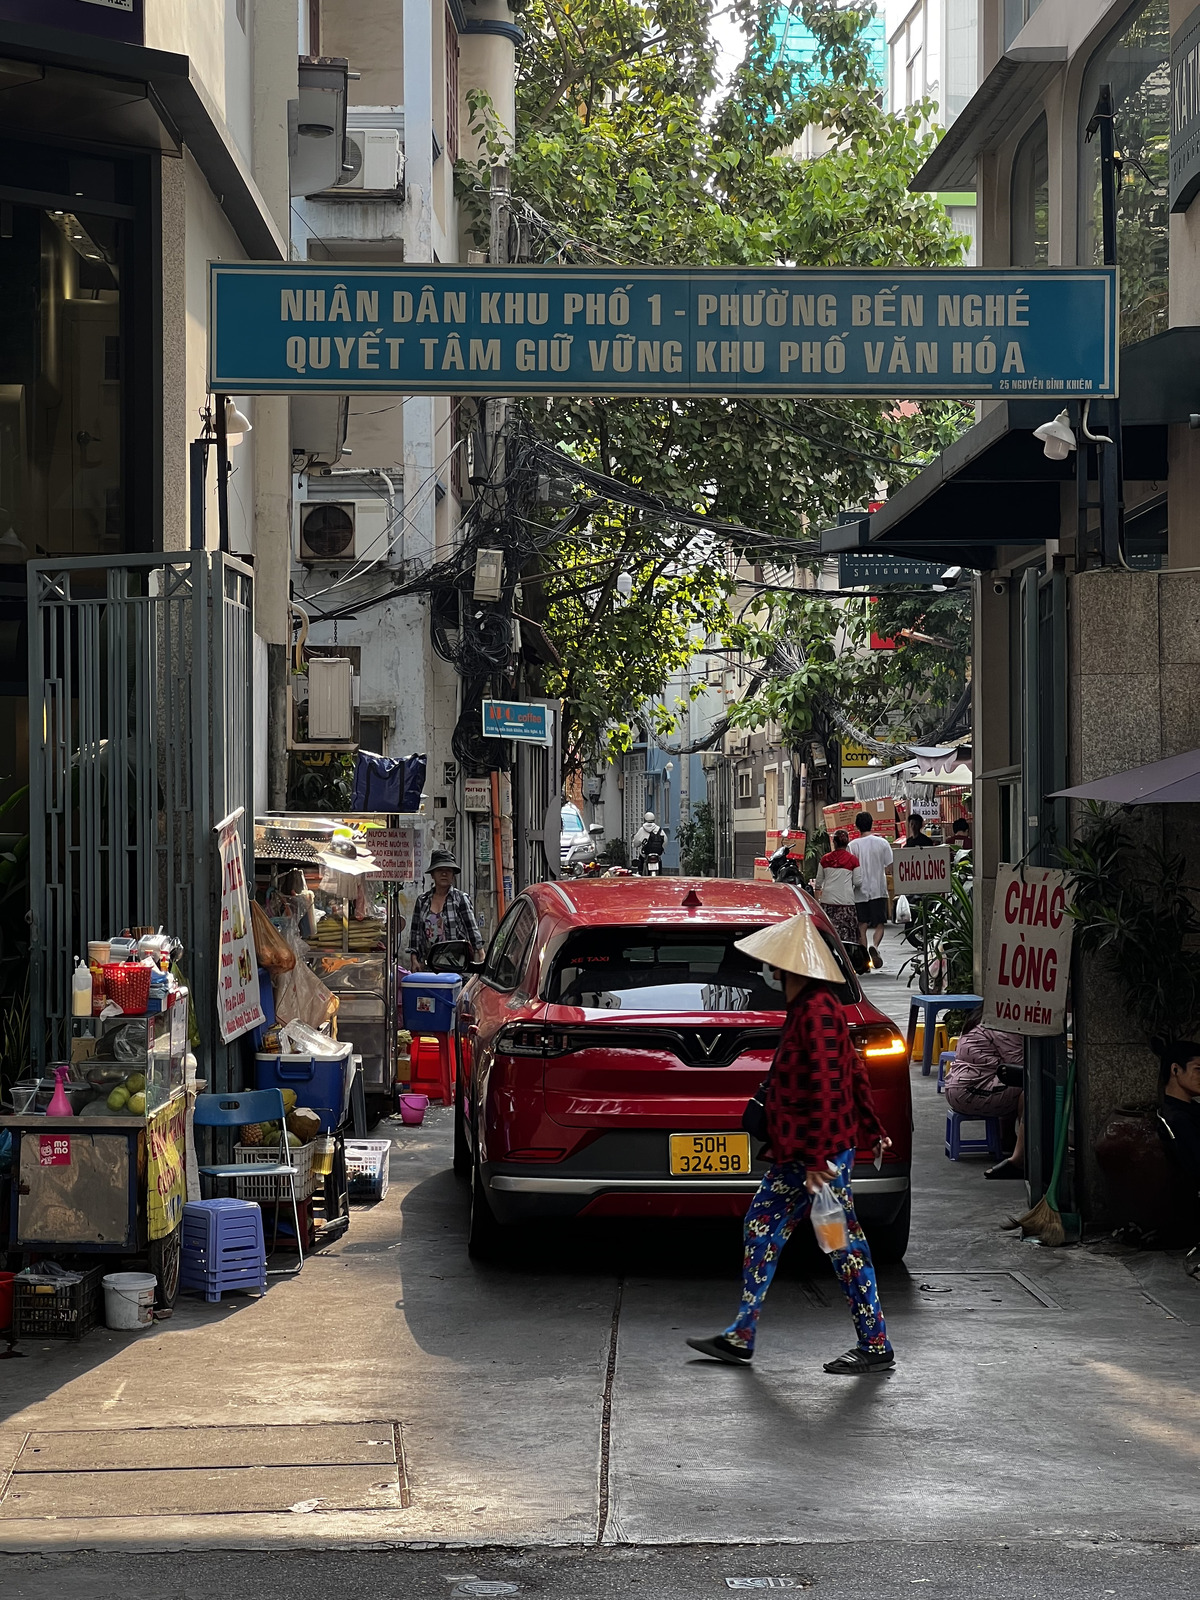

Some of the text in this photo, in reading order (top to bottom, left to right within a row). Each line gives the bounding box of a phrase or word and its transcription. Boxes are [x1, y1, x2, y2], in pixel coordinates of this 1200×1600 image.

[280, 283, 379, 323] NHÂN
[393, 285, 466, 324] DÂN
[480, 292, 549, 325] KHU
[563, 284, 634, 326] PHỐ
[647, 293, 661, 326] 1
[698, 288, 837, 327] PHƯỜNG
[851, 285, 923, 327] BẾN
[937, 288, 1030, 327] NGHÉ
[286, 328, 1026, 374] QUYẾT TÂM GIỮ VỮNG KHU PHỐ VĂN HÓA
[999, 380, 1010, 389] 25
[1012, 376, 1044, 389] NGUYỄN
[1066, 377, 1093, 389] KHIÊM
[518, 712, 542, 722] coffee
[368, 830, 387, 838] NƯỚC
[899, 854, 946, 881] CHÁO LÒNG
[1004, 872, 1065, 929] CHÁO
[998, 933, 1058, 992] LÒNG
[996, 998, 1052, 1025] VÀO HẺM
[693, 1137, 727, 1153] 50H
[680, 1155, 741, 1172] 324.98
